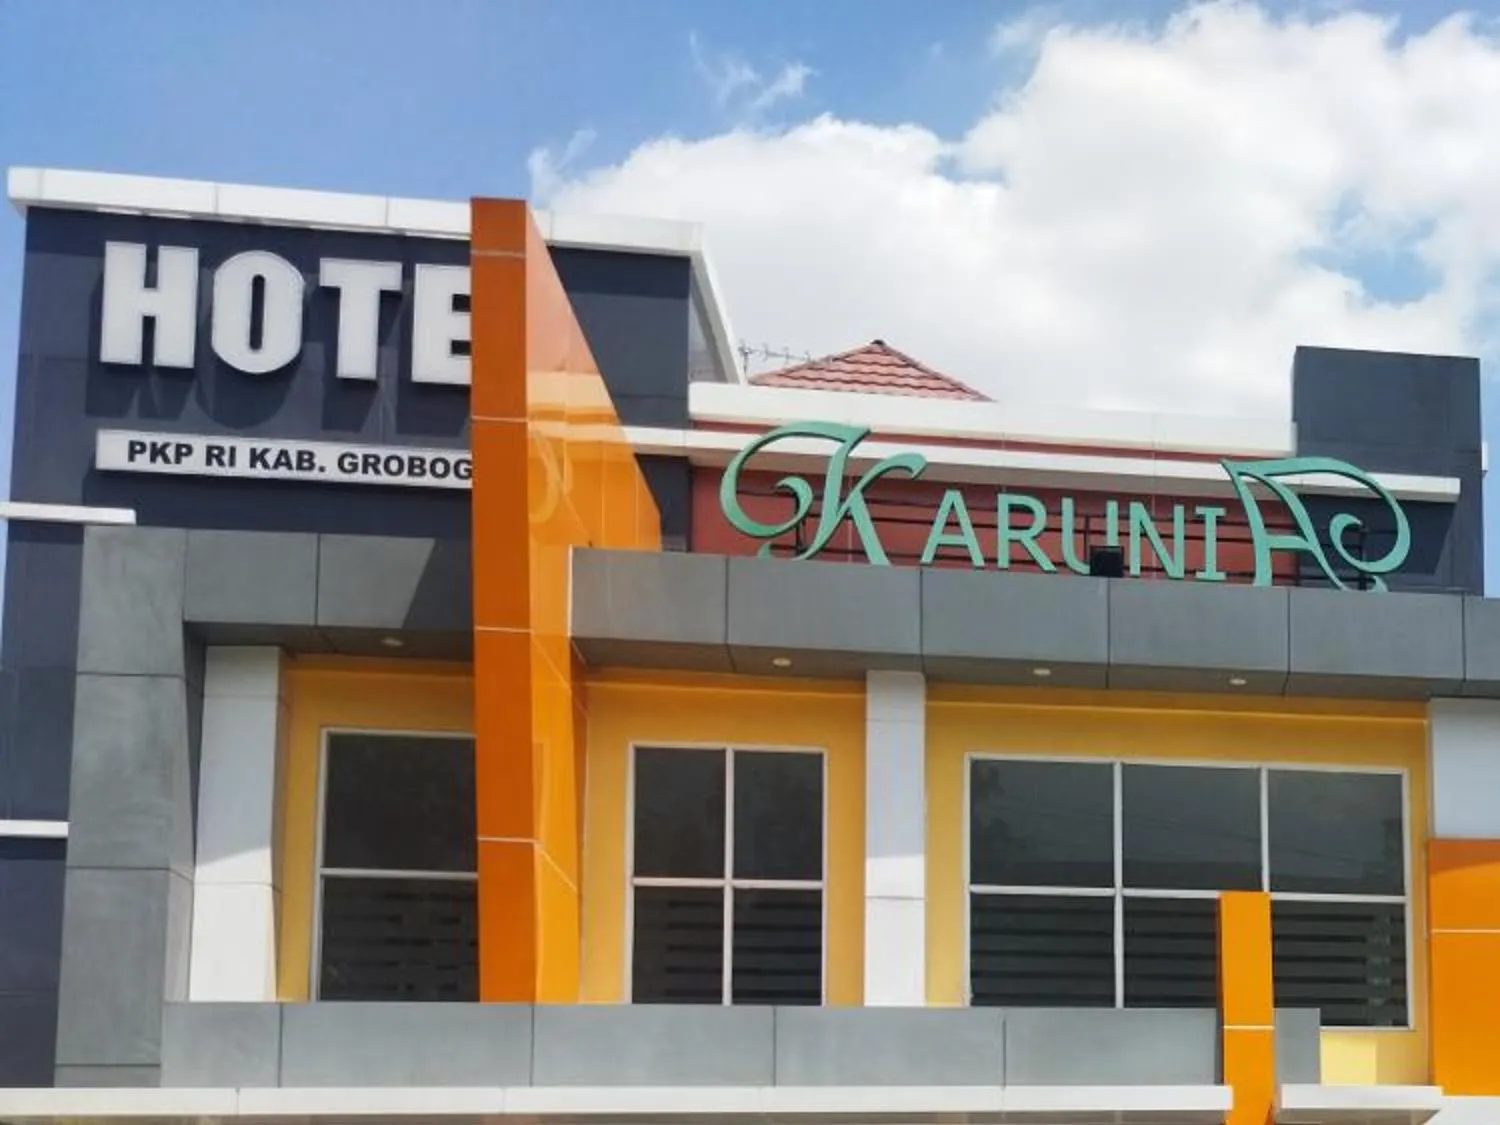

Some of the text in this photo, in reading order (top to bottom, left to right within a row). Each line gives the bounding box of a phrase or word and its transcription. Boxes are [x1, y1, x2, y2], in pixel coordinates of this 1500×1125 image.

[100, 241, 471, 385] HOTE
[127, 440, 472, 480] PKP RI KAB. GROBOG
[720, 421, 1410, 592] KARUNIA
